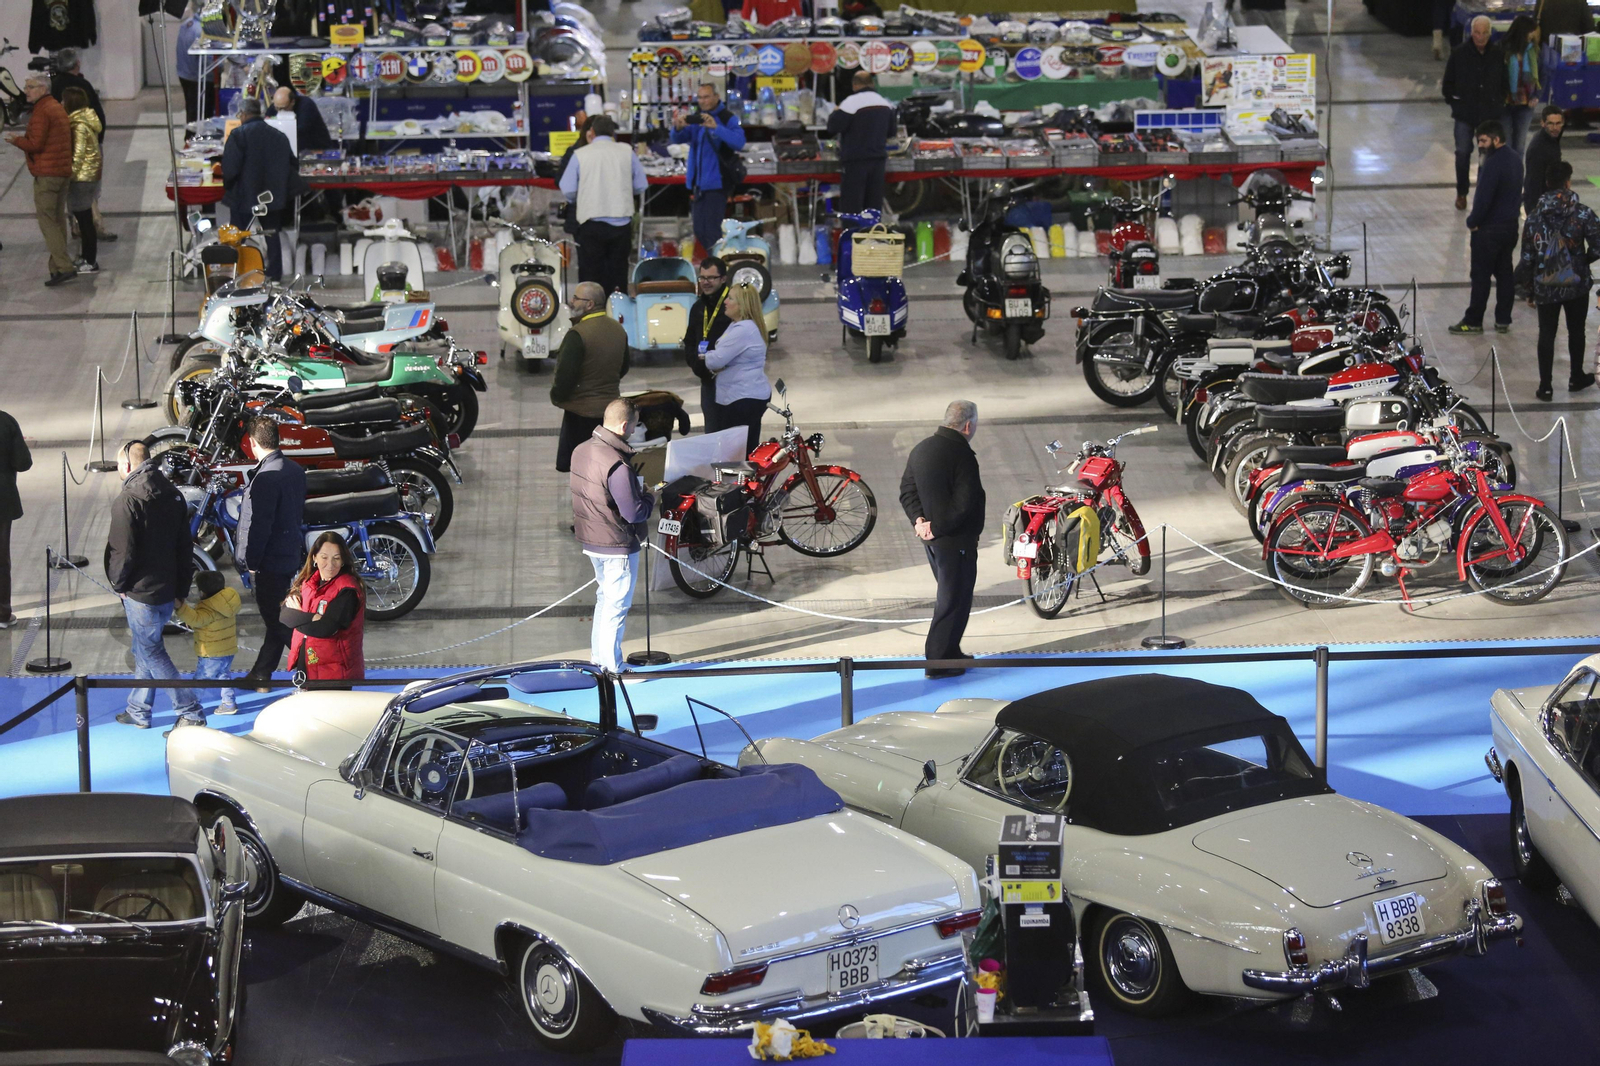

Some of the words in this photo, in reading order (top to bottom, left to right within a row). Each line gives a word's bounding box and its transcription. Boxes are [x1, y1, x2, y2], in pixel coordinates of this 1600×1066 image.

[380, 60, 400, 75] SEAT
[867, 325, 888, 334] 8405
[526, 345, 546, 354] 3408
[1354, 378, 1388, 389] OSSA
[1377, 904, 1389, 922] H
[1390, 897, 1417, 918] BBB
[1386, 916, 1420, 939] 8338
[831, 955, 840, 971] H
[842, 945, 877, 968] 0373
[840, 966, 869, 988] BBB
